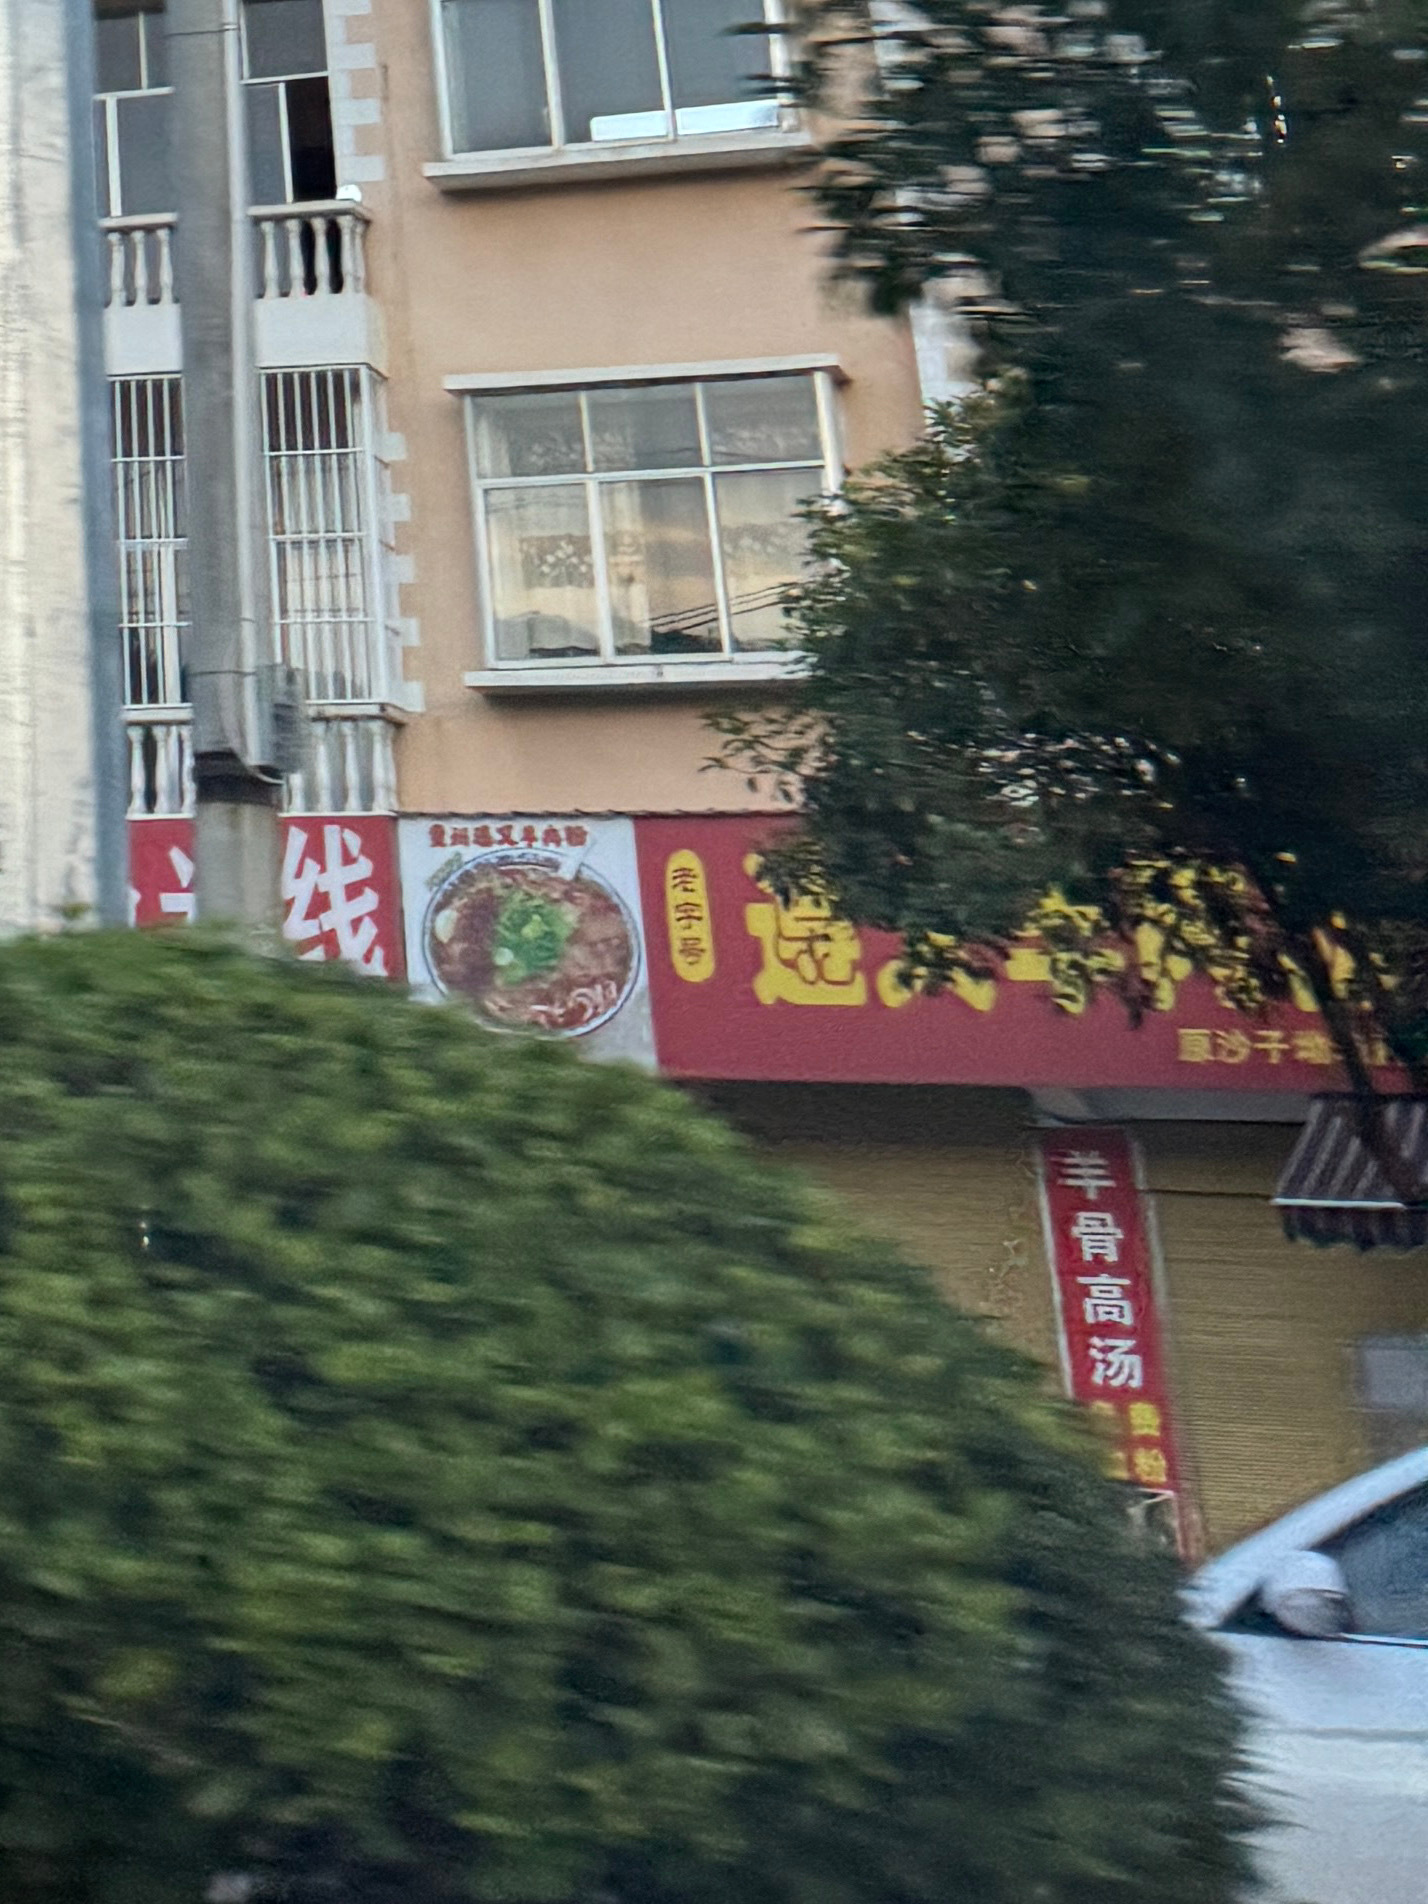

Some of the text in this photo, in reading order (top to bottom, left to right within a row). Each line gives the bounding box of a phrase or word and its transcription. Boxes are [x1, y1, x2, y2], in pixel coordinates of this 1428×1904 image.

[671, 867, 707, 965] 老字号
[1053, 1150, 1144, 1388] 羊骨高汤
